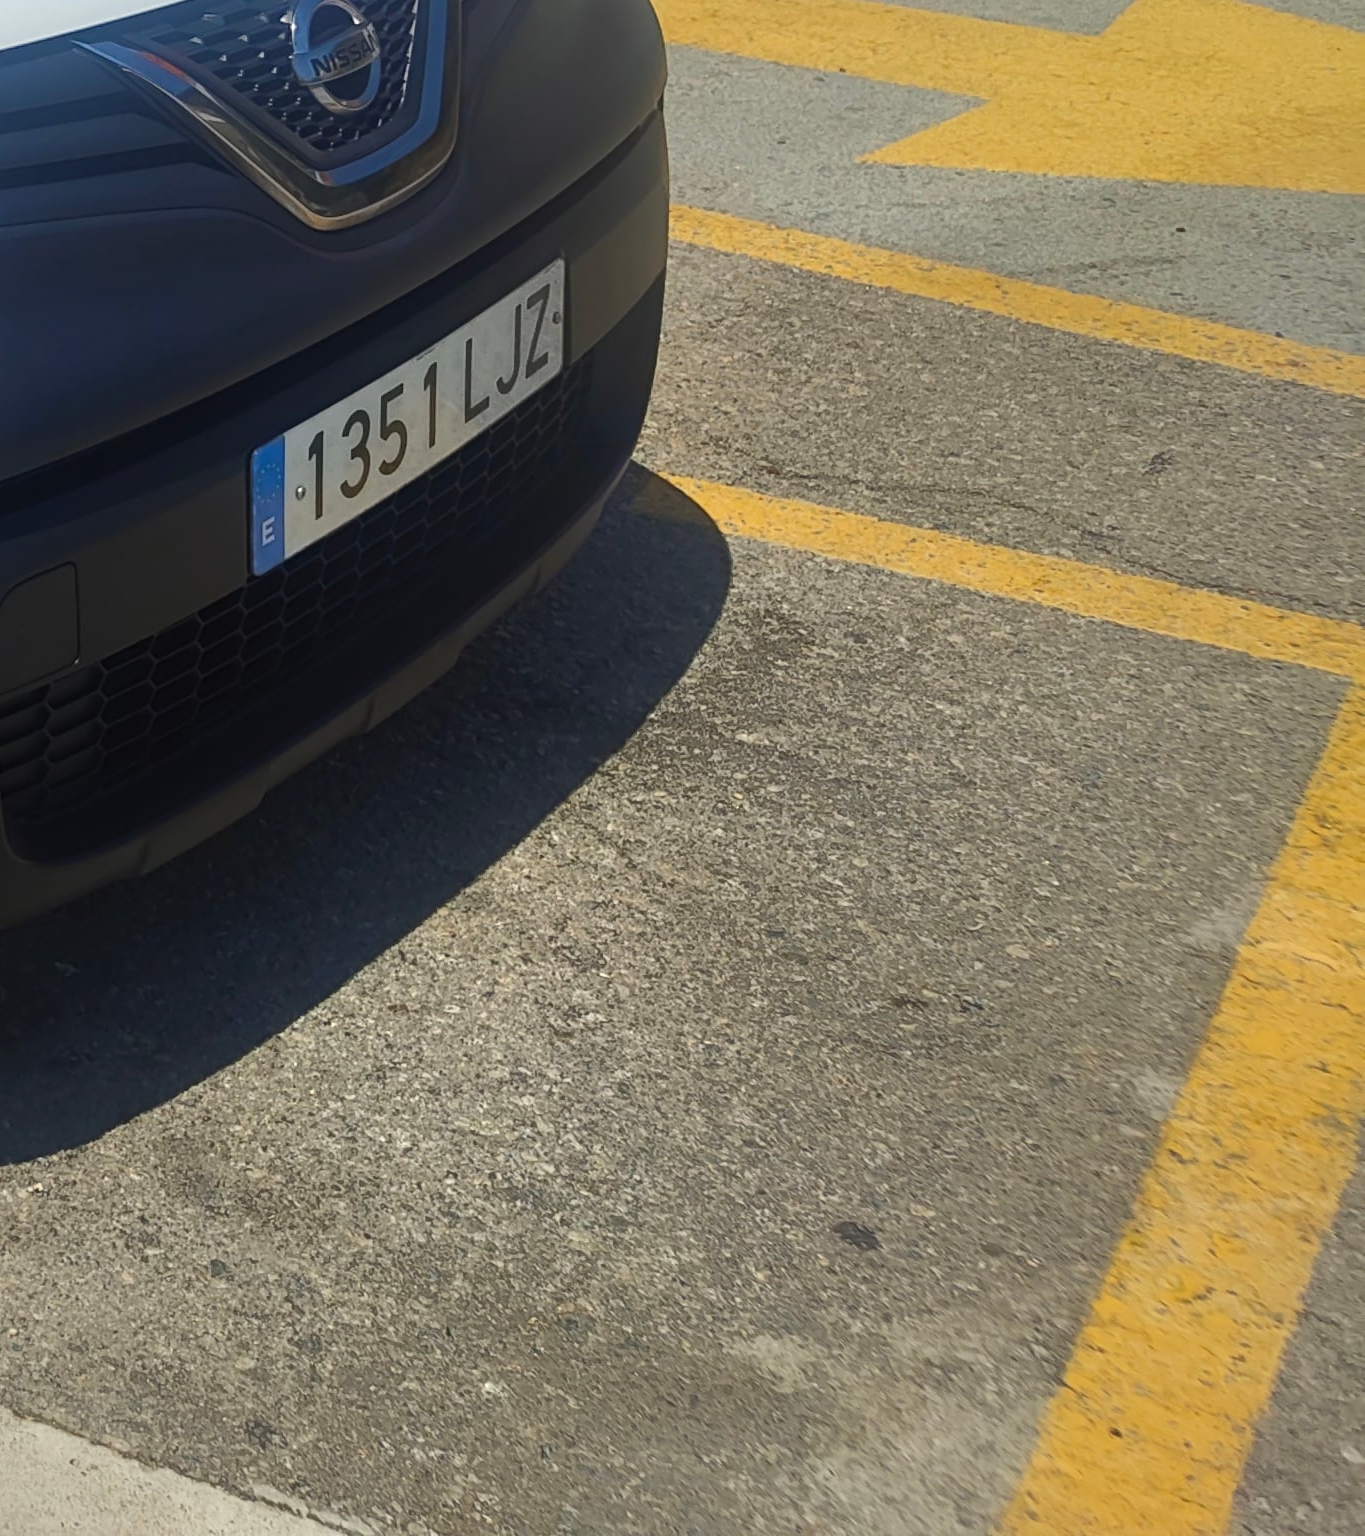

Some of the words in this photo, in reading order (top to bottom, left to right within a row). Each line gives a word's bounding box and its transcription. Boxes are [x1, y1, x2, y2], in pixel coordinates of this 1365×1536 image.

[307, 360, 440, 521] 1351
[463, 283, 552, 424] LJZ
[261, 516, 276, 547] E
